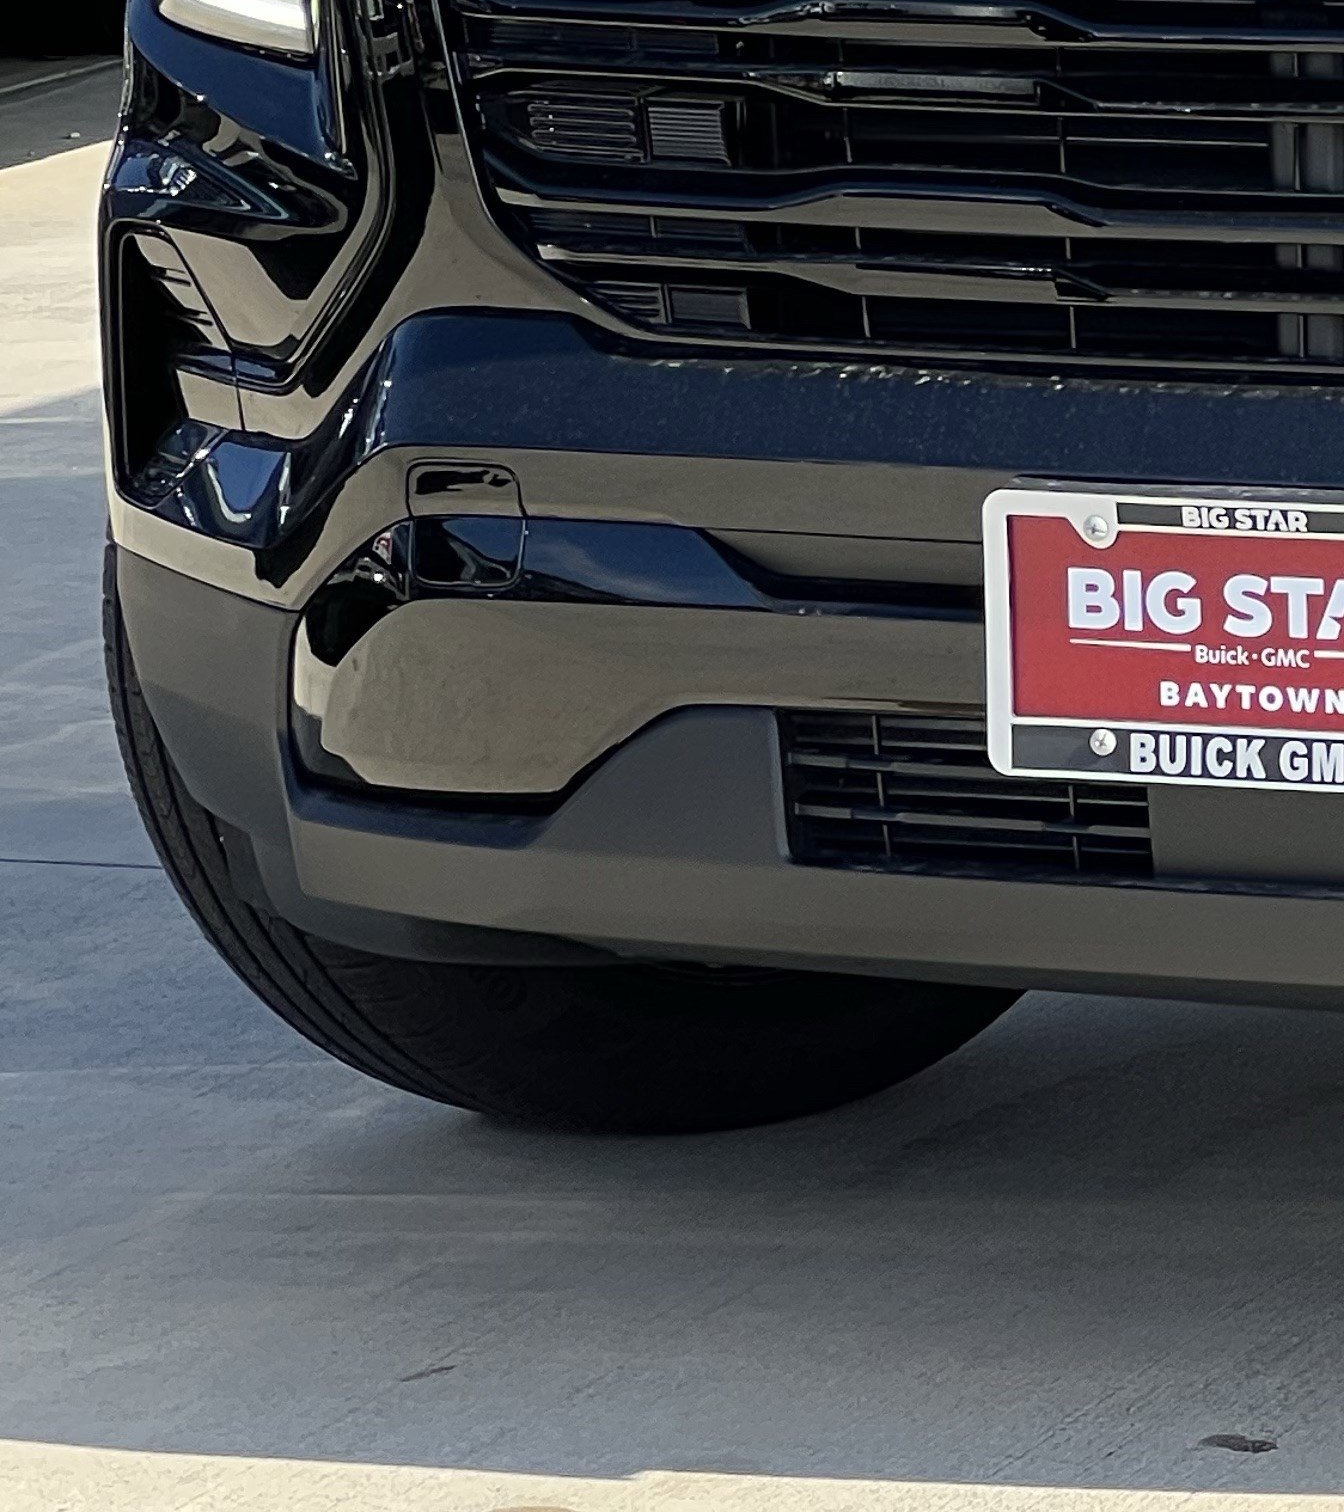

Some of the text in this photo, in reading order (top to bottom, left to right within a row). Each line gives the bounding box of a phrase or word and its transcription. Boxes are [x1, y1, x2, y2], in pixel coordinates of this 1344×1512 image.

[1181, 506, 1308, 532] BIG STAR
[1066, 567, 1202, 634] BIG
[1195, 645, 1310, 669] Buick GMC
[1129, 733, 1266, 779] BUICK
